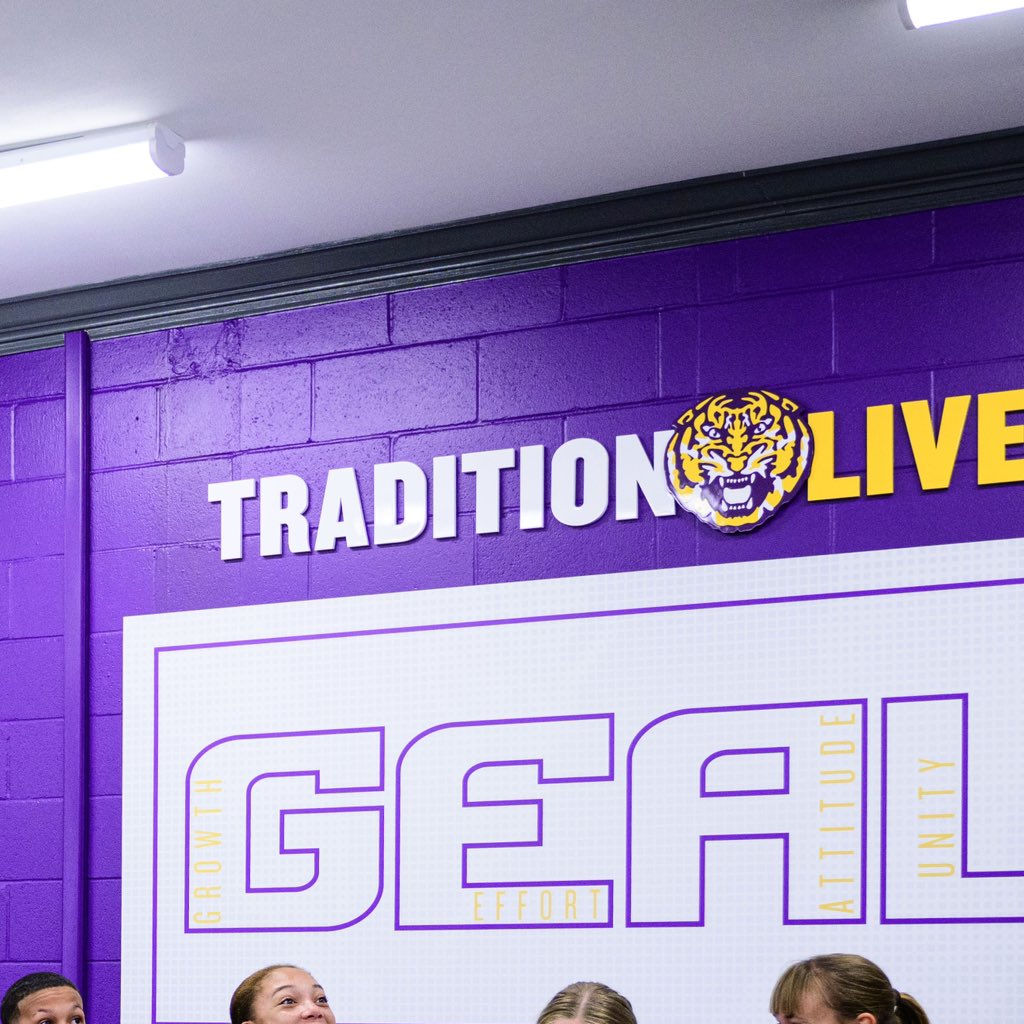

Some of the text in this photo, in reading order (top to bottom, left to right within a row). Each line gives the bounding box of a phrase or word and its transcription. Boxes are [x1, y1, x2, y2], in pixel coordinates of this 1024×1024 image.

[207, 389, 1024, 561] TRADITION LIVE
[192, 776, 223, 926] GROWTH
[819, 713, 856, 914] ATTITUDE
[917, 758, 956, 878] UNITY
[472, 887, 601, 922] EFFORT
